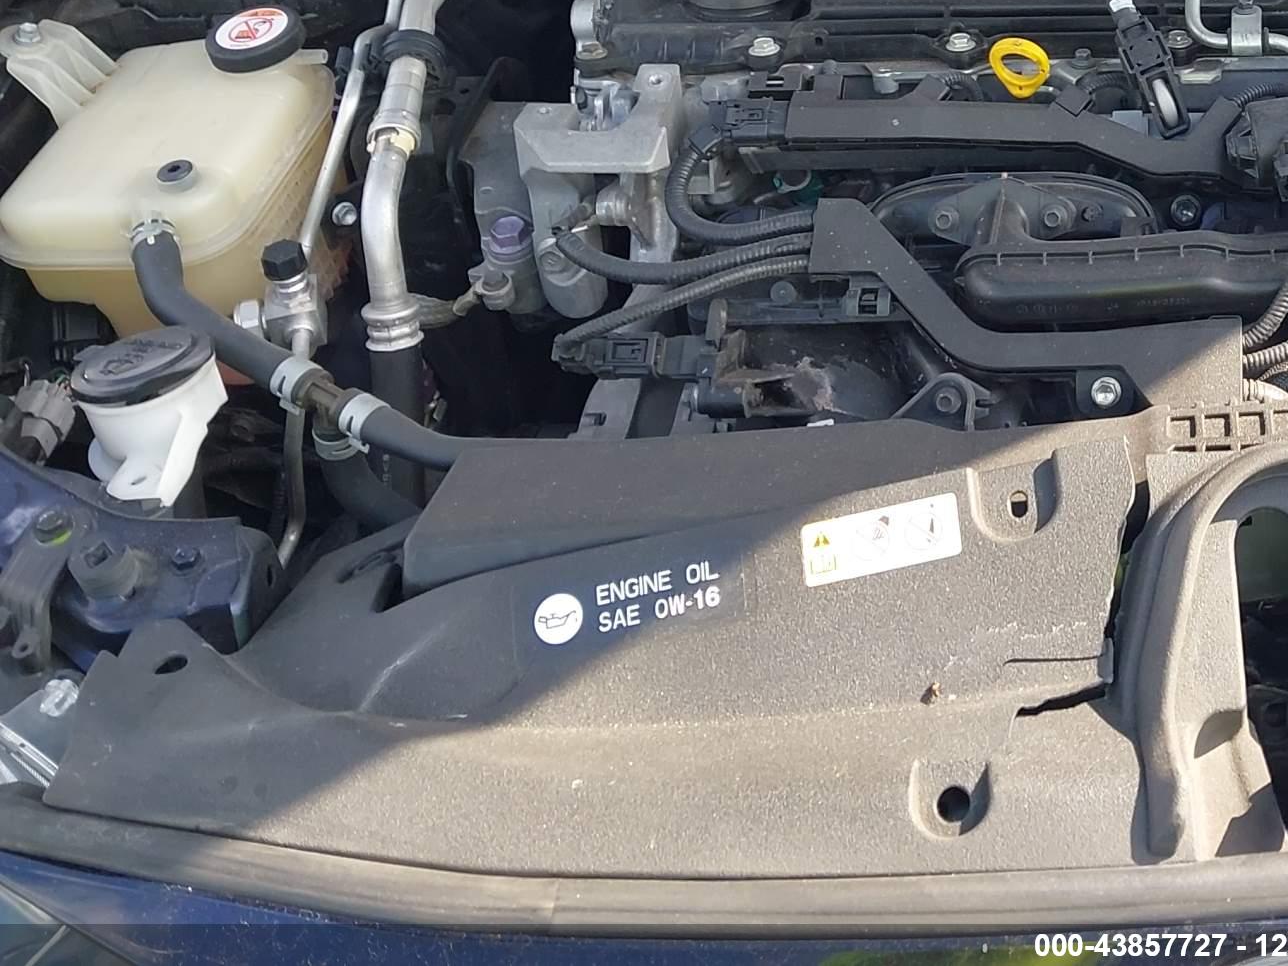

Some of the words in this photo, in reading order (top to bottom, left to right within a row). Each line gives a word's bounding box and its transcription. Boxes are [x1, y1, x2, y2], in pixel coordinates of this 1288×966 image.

[596, 569, 673, 606] ENGINE
[686, 560, 721, 585] OIL
[598, 604, 641, 633] SAE
